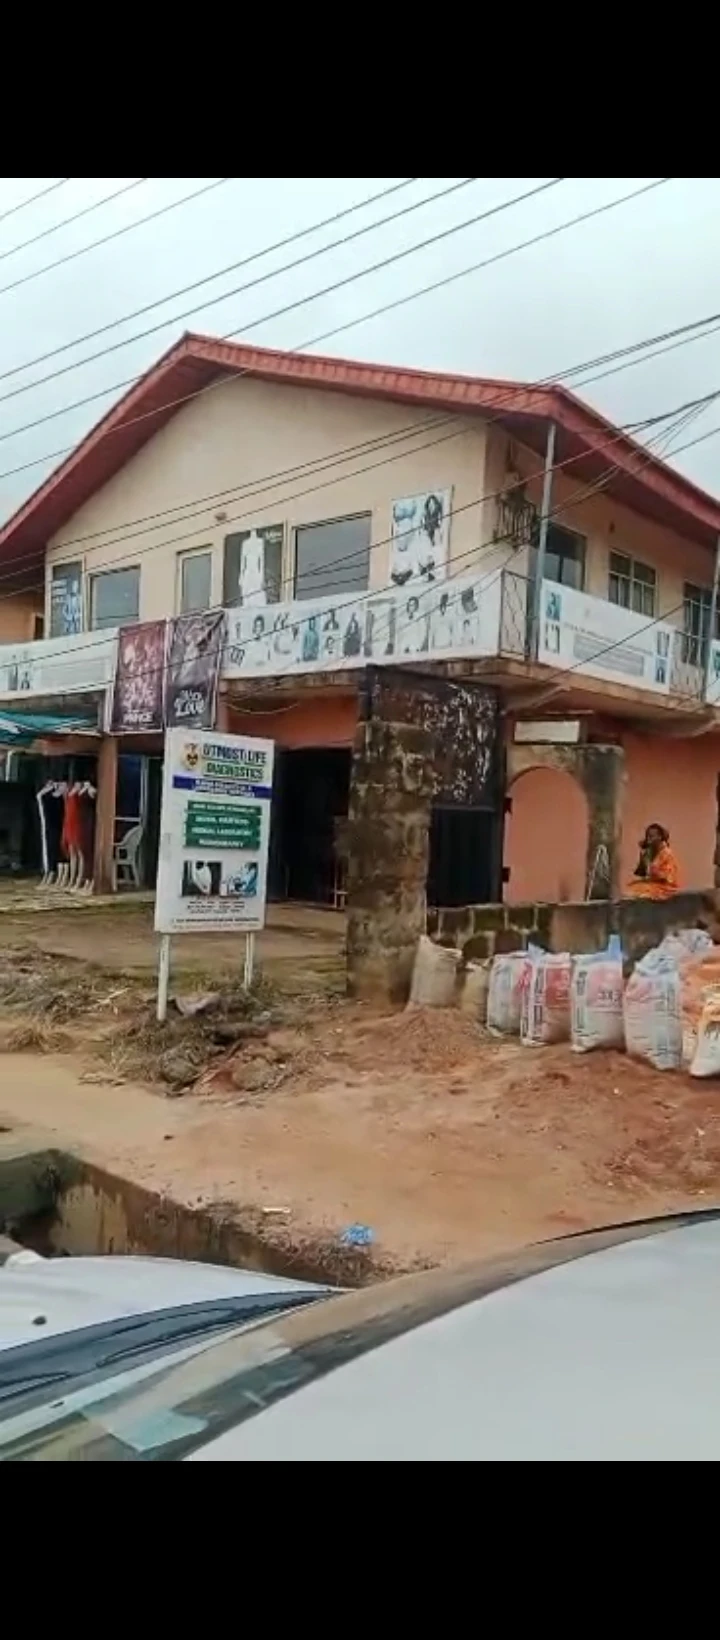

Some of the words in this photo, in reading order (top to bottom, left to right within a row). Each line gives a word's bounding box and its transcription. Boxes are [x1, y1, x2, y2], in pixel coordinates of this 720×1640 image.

[203, 743, 243, 760] UTMOST
[248, 750, 267, 763] LIFE
[206, 762, 264, 779] DIAGNOSTICS
